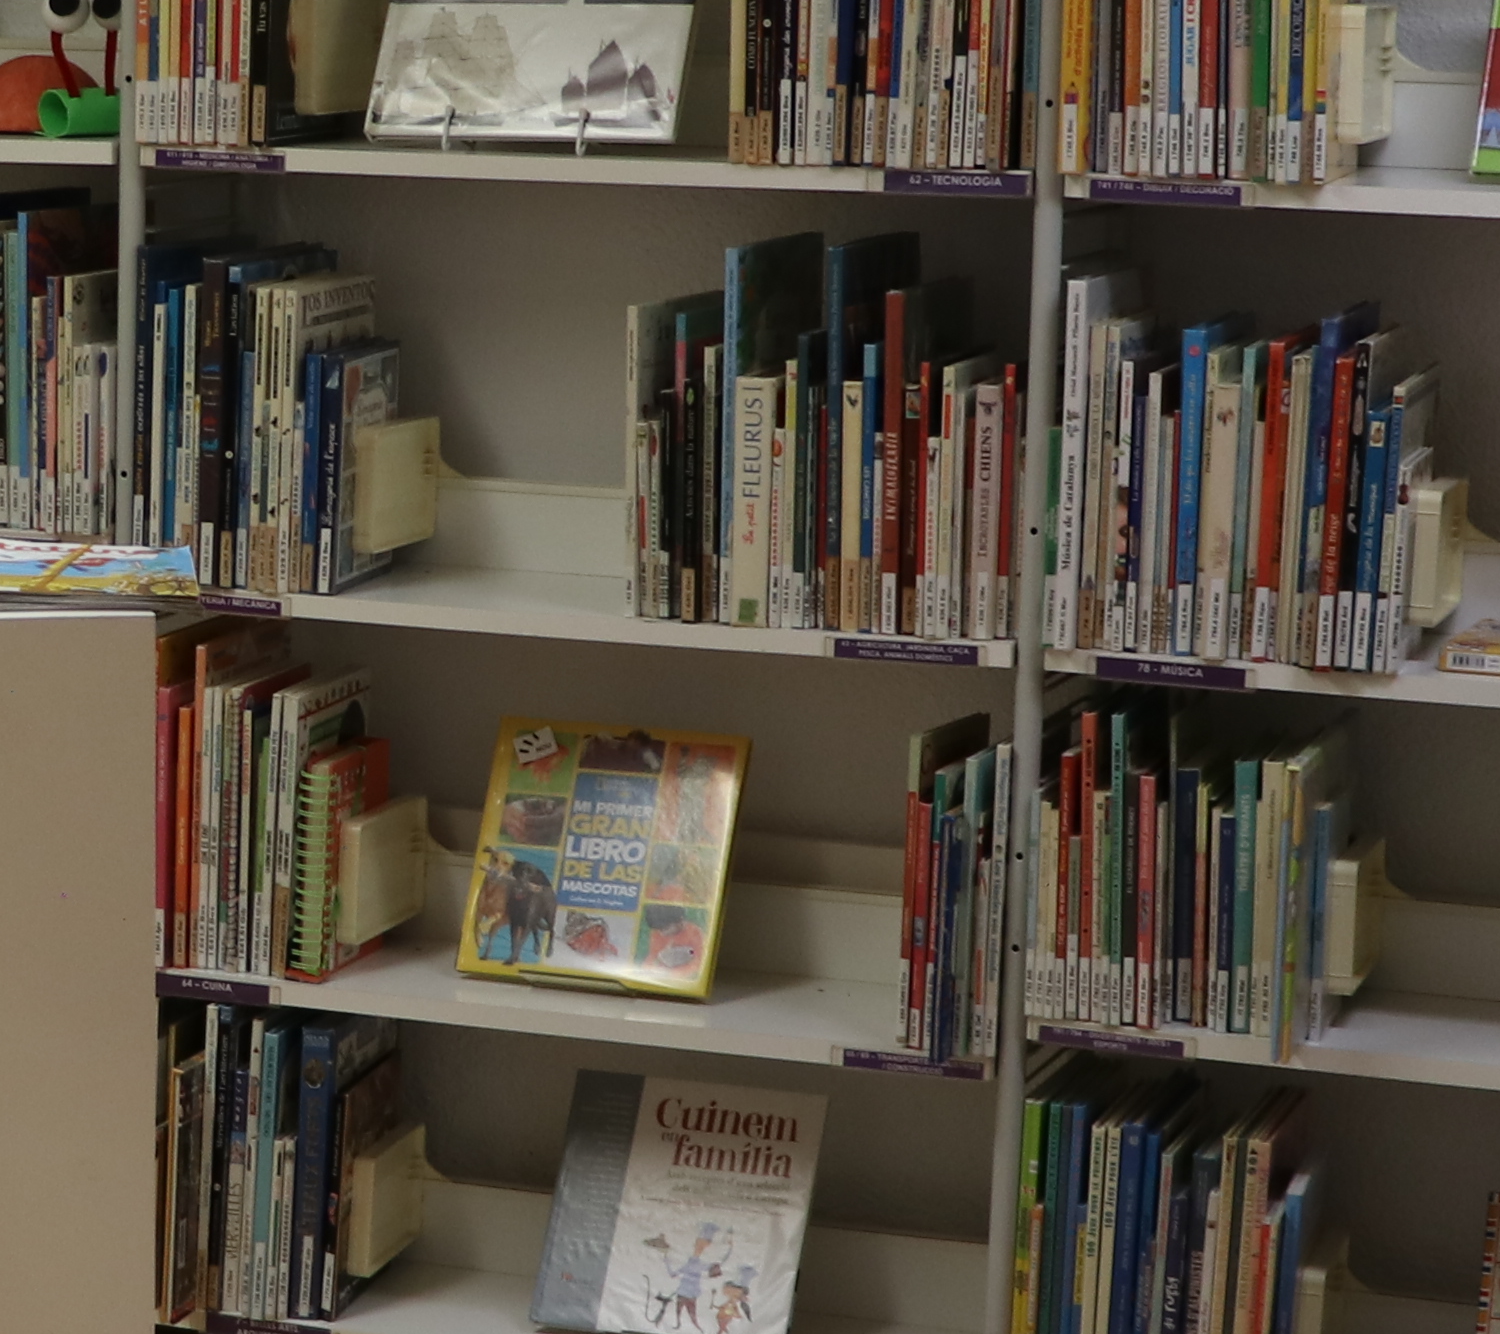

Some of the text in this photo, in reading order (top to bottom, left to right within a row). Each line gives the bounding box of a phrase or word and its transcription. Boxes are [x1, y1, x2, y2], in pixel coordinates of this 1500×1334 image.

[1185, 26, 1196, 67] JUGAR
[909, 175, 1003, 188] 62 TECNOLOGIA
[741, 397, 764, 497] FLEURUS
[979, 426, 992, 483] CHIENS
[1062, 454, 1077, 512] Catalunya
[1137, 662, 1204, 678] 78 MÚSICA
[595, 801, 653, 818] PRIMER
[570, 813, 649, 838] GRAN
[565, 835, 647, 864] LIBRO
[563, 858, 640, 882] DE LAS
[562, 879, 639, 897] MASCOTAS
[201, 980, 233, 993] CUINA
[656, 1097, 799, 1144] Cuinem
[673, 1132, 793, 1179] família
